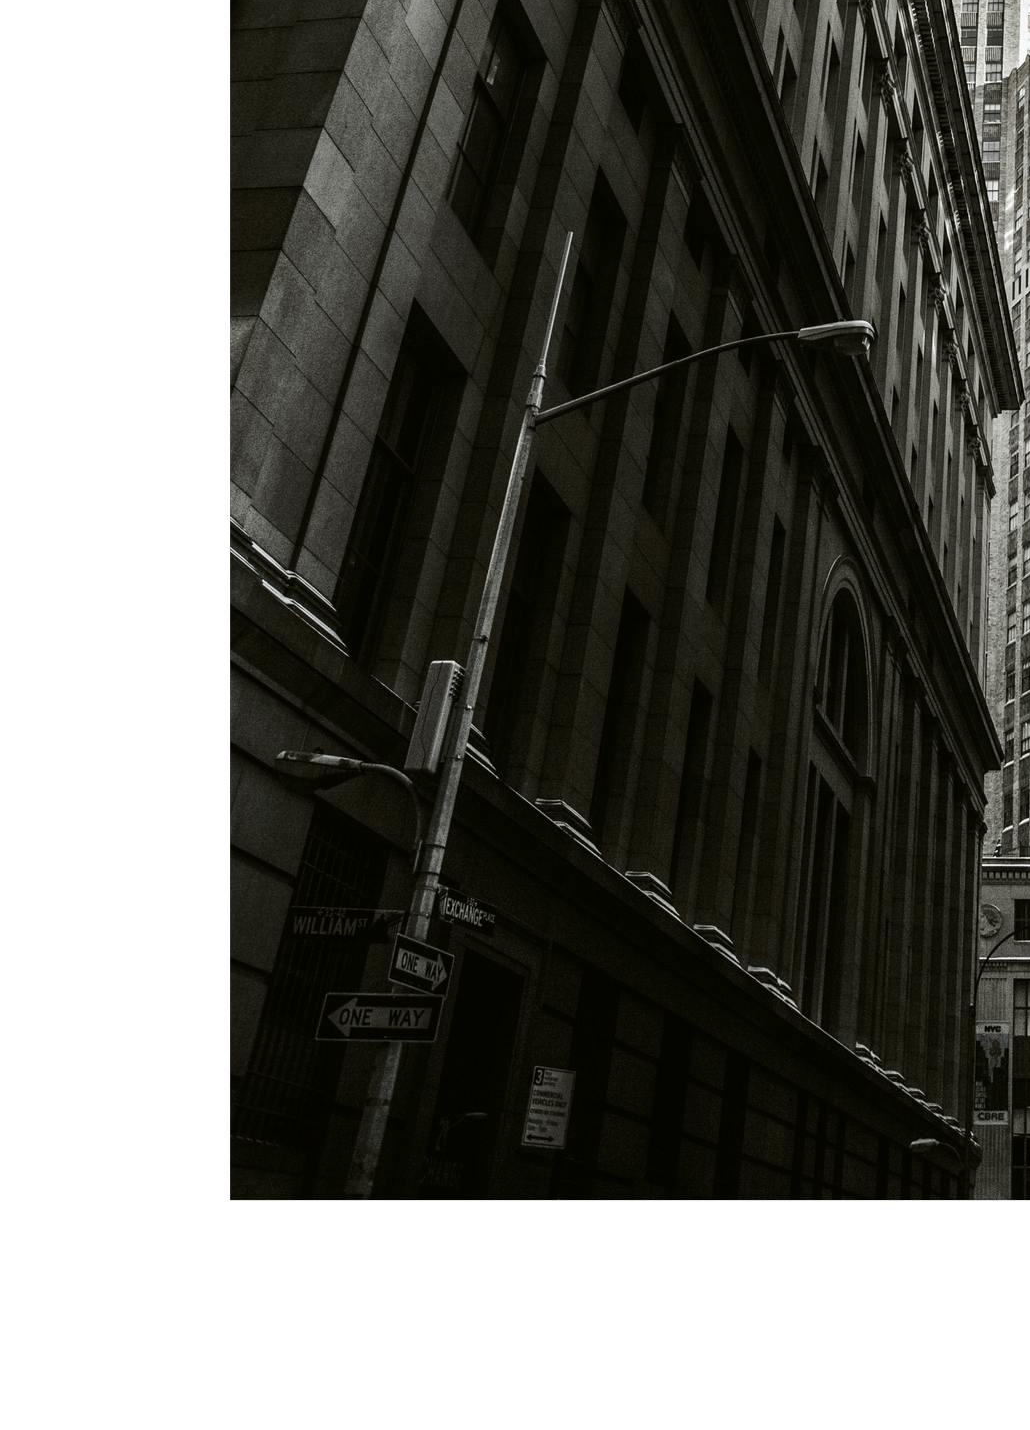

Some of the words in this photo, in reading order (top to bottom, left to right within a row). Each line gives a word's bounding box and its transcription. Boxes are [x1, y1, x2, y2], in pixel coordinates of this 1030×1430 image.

[446, 897, 483, 927] EXCHANGE
[293, 915, 358, 937] WILLIAM
[357, 917, 369, 928] ST
[401, 952, 420, 971] ONE
[425, 962, 444, 982] WAY
[340, 1008, 373, 1026] ONE
[388, 1009, 425, 1026] WAY
[985, 1025, 1002, 1033] NYC
[535, 1069, 543, 1084] 3
[977, 1112, 1005, 1121] CBRE
